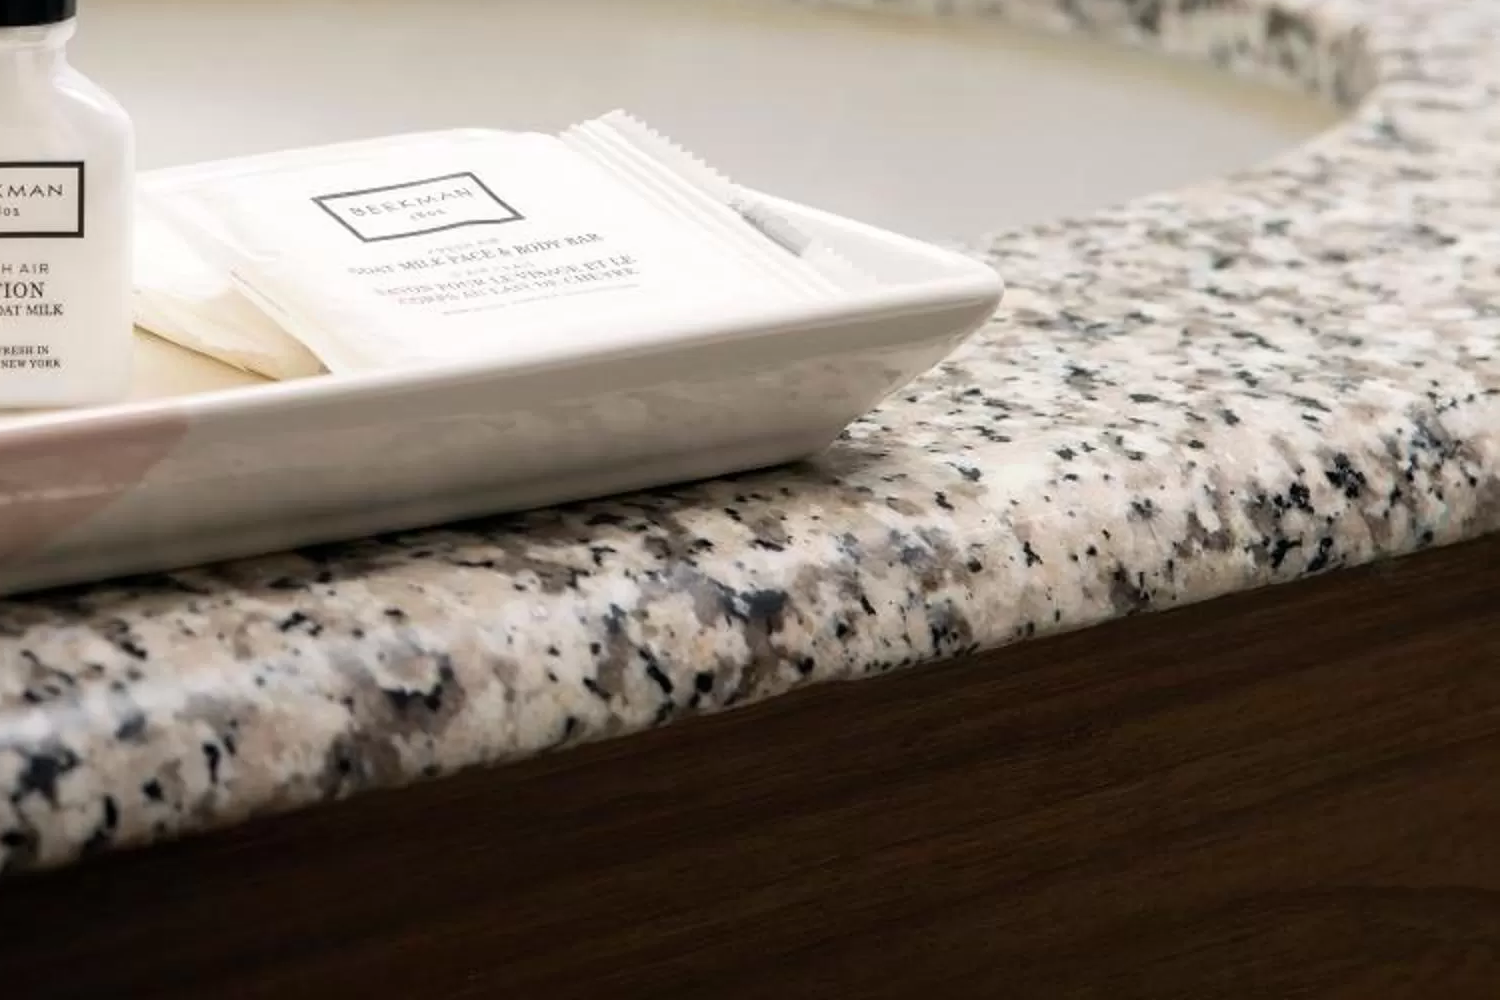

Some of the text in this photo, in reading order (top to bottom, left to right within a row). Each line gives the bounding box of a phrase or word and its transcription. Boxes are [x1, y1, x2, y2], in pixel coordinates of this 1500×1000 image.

[348, 187, 474, 217] BEEKMAN
[398, 256, 446, 271] MILK
[512, 239, 561, 256] BODY
[564, 233, 604, 247] BAR
[19, 263, 50, 275] AIR
[25, 303, 64, 317] MILK
[37, 345, 49, 355] IN
[0, 359, 27, 370] NEW
[29, 359, 62, 370] YORK
